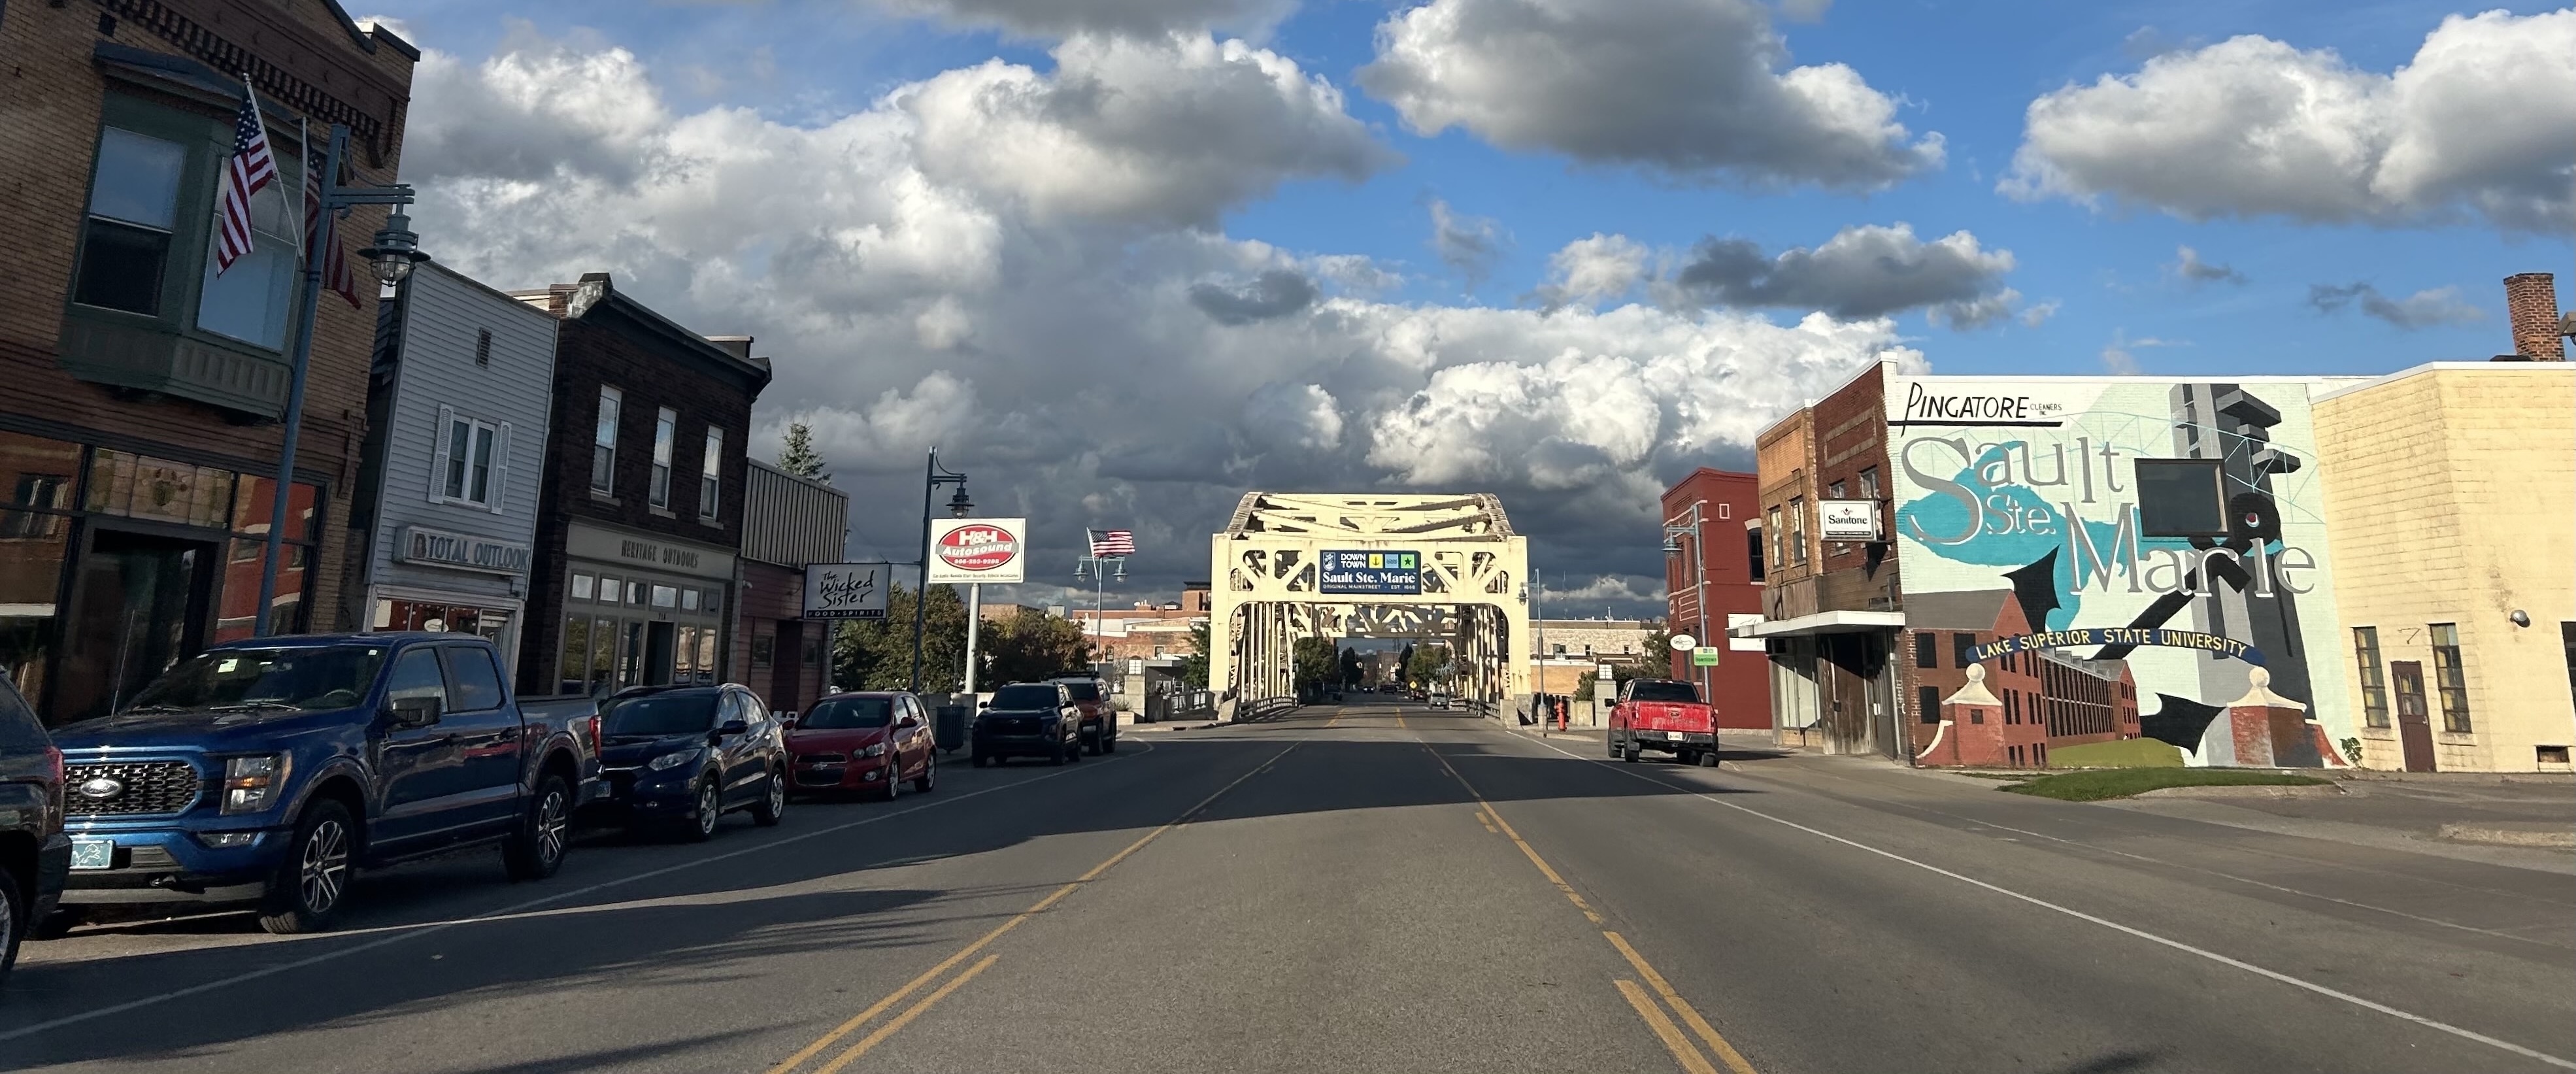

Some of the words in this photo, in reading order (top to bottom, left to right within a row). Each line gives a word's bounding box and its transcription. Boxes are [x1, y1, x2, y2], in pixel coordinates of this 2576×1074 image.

[1901, 382, 2029, 438] PINGATORE
[1901, 437, 2124, 545] Sault
[1828, 514, 1867, 524] Sanitone
[1986, 495, 2056, 535] Ste.
[942, 543, 1012, 556] Autosound
[959, 530, 997, 546] H&H
[2060, 502, 2317, 597] Marie
[429, 535, 468, 562] TOTAL
[474, 543, 530, 570] OUTLOOK
[622, 540, 656, 562] HERITAGE
[663, 548, 699, 568] OUTDOORS
[820, 569, 875, 594] Wicked
[822, 570, 837, 580] The
[1322, 571, 1353, 583] Sault
[1356, 571, 1377, 583] Ste.
[818, 590, 873, 609] Sister
[1976, 639, 2013, 659] LAKE
[2019, 631, 2090, 650] SUPERIOR
[2103, 629, 2151, 643] STATE
[2161, 630, 2247, 657] UNIVERSITY
